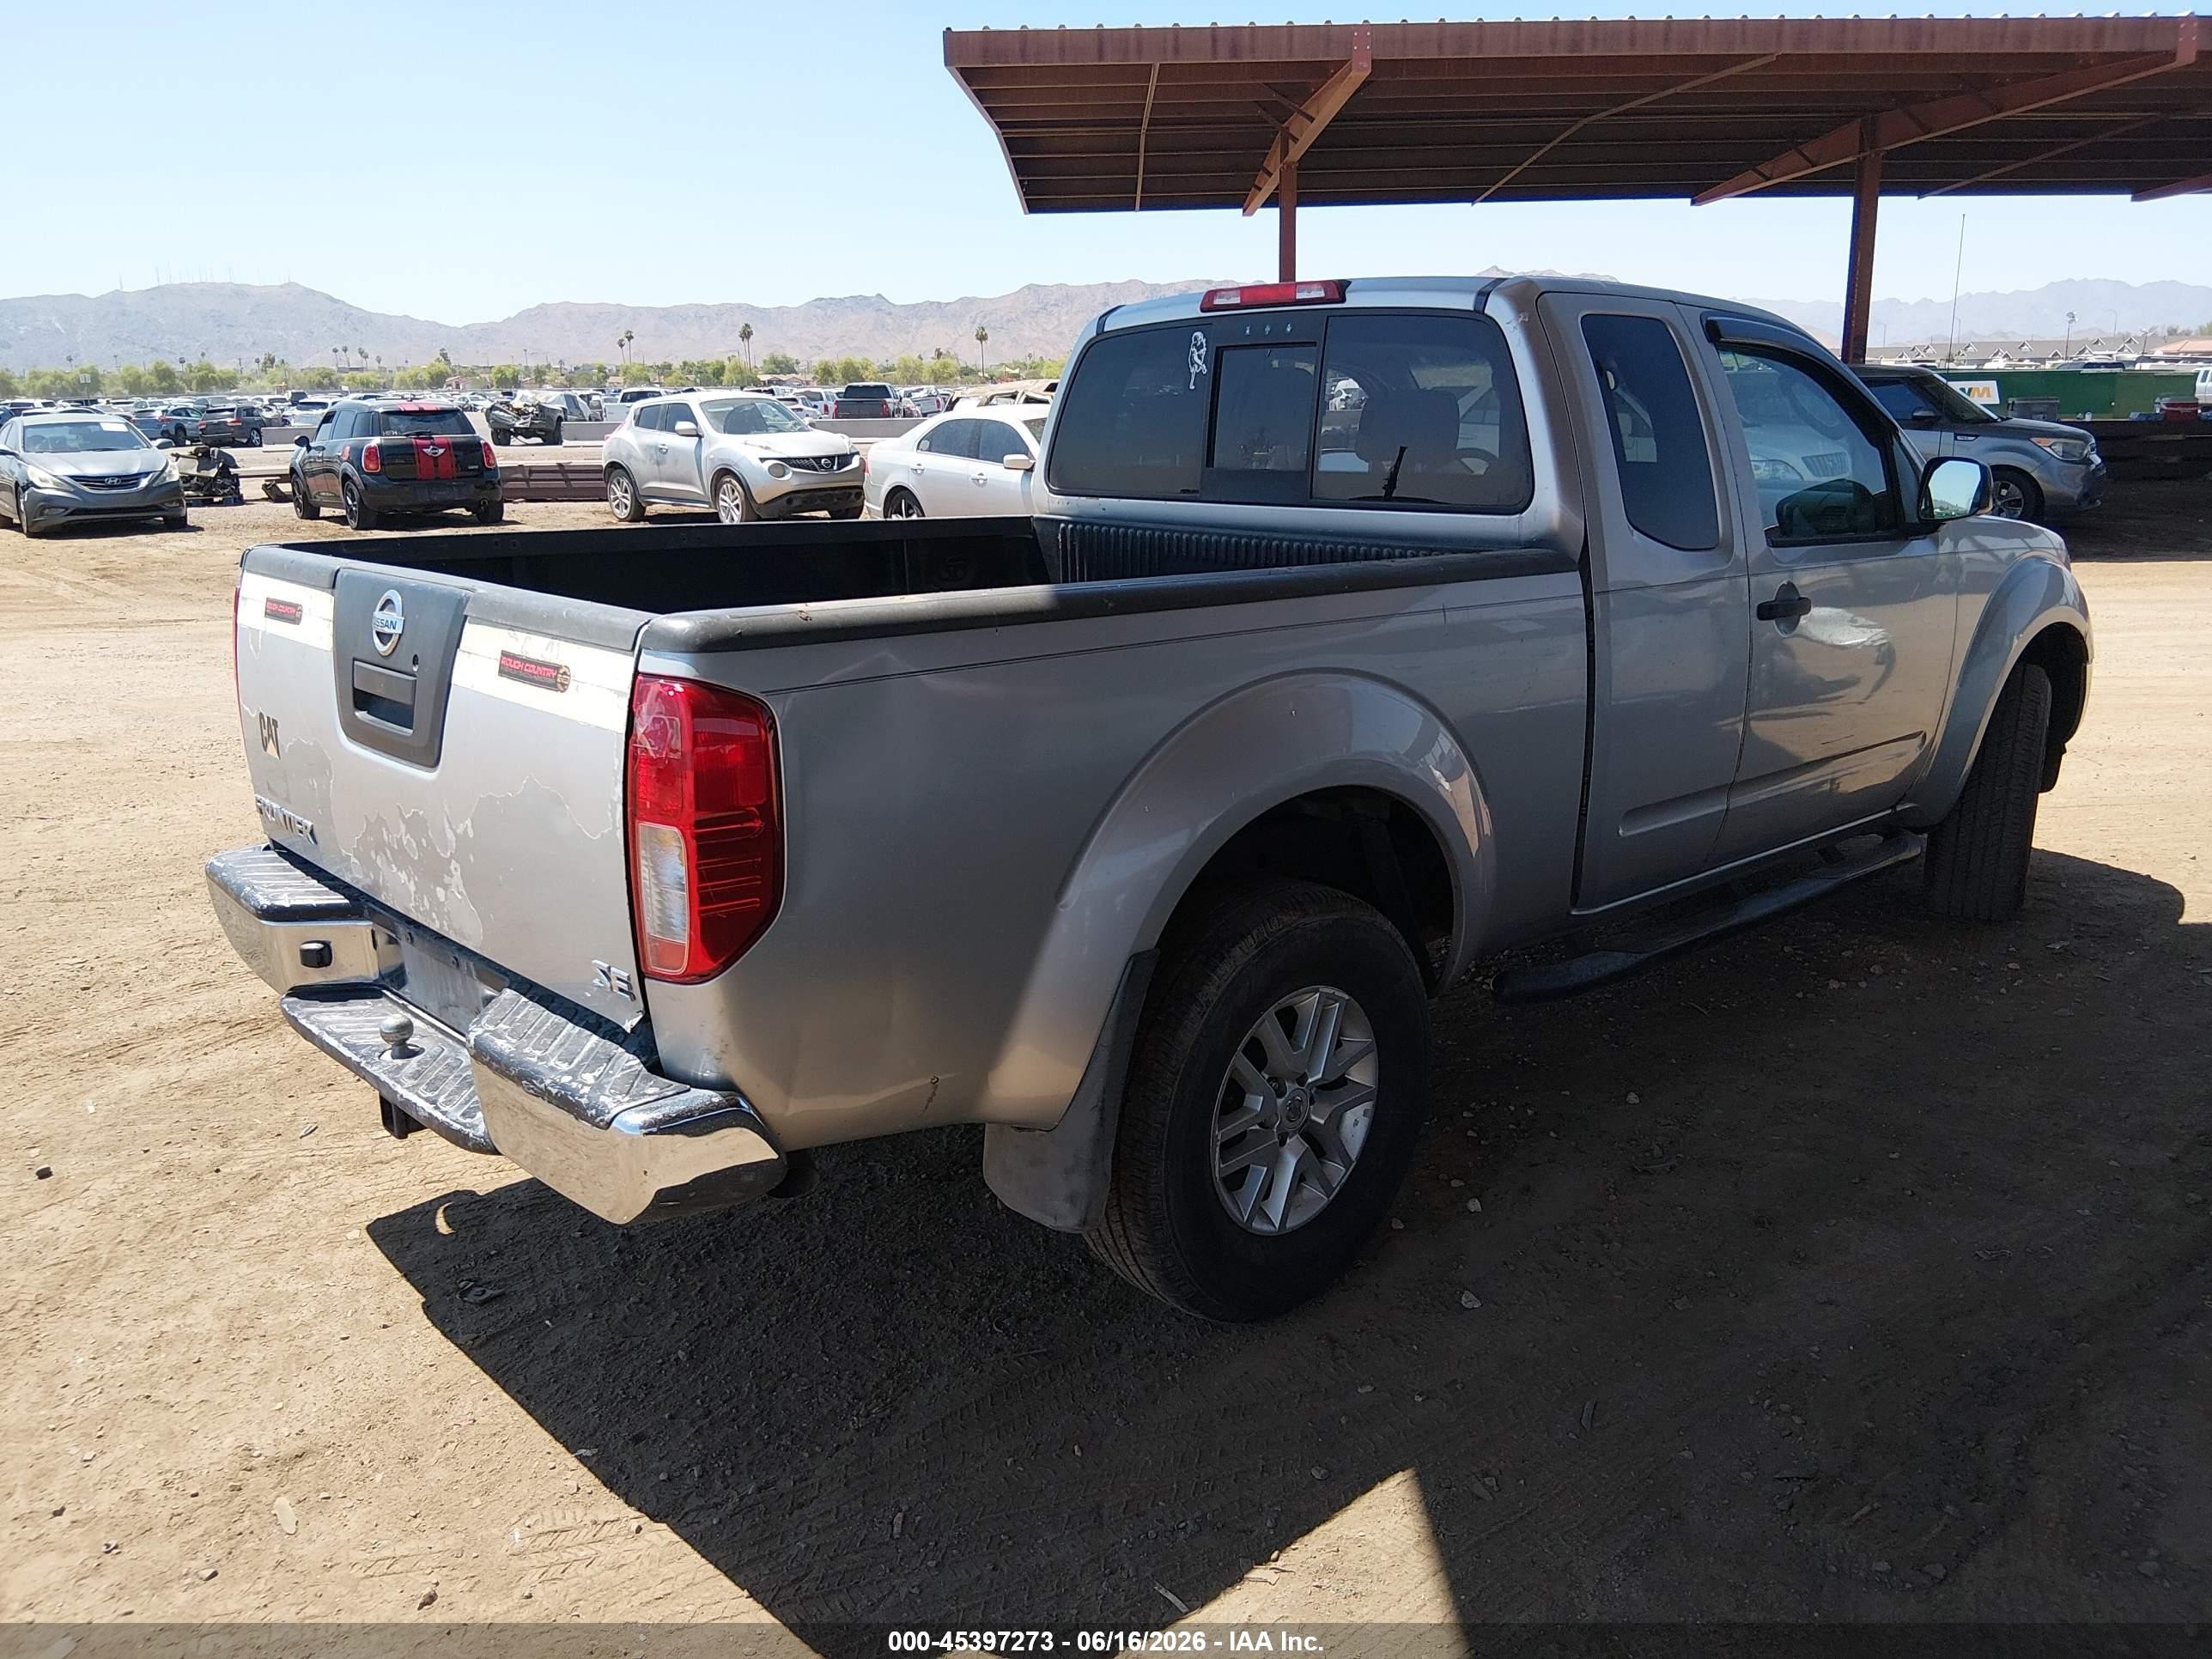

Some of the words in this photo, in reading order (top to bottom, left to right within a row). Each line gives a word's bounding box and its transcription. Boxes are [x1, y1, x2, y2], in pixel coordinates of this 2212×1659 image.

[501, 656, 524, 671] ROUGH
[524, 663, 557, 679] COUNTRY
[258, 711, 282, 761] CAT
